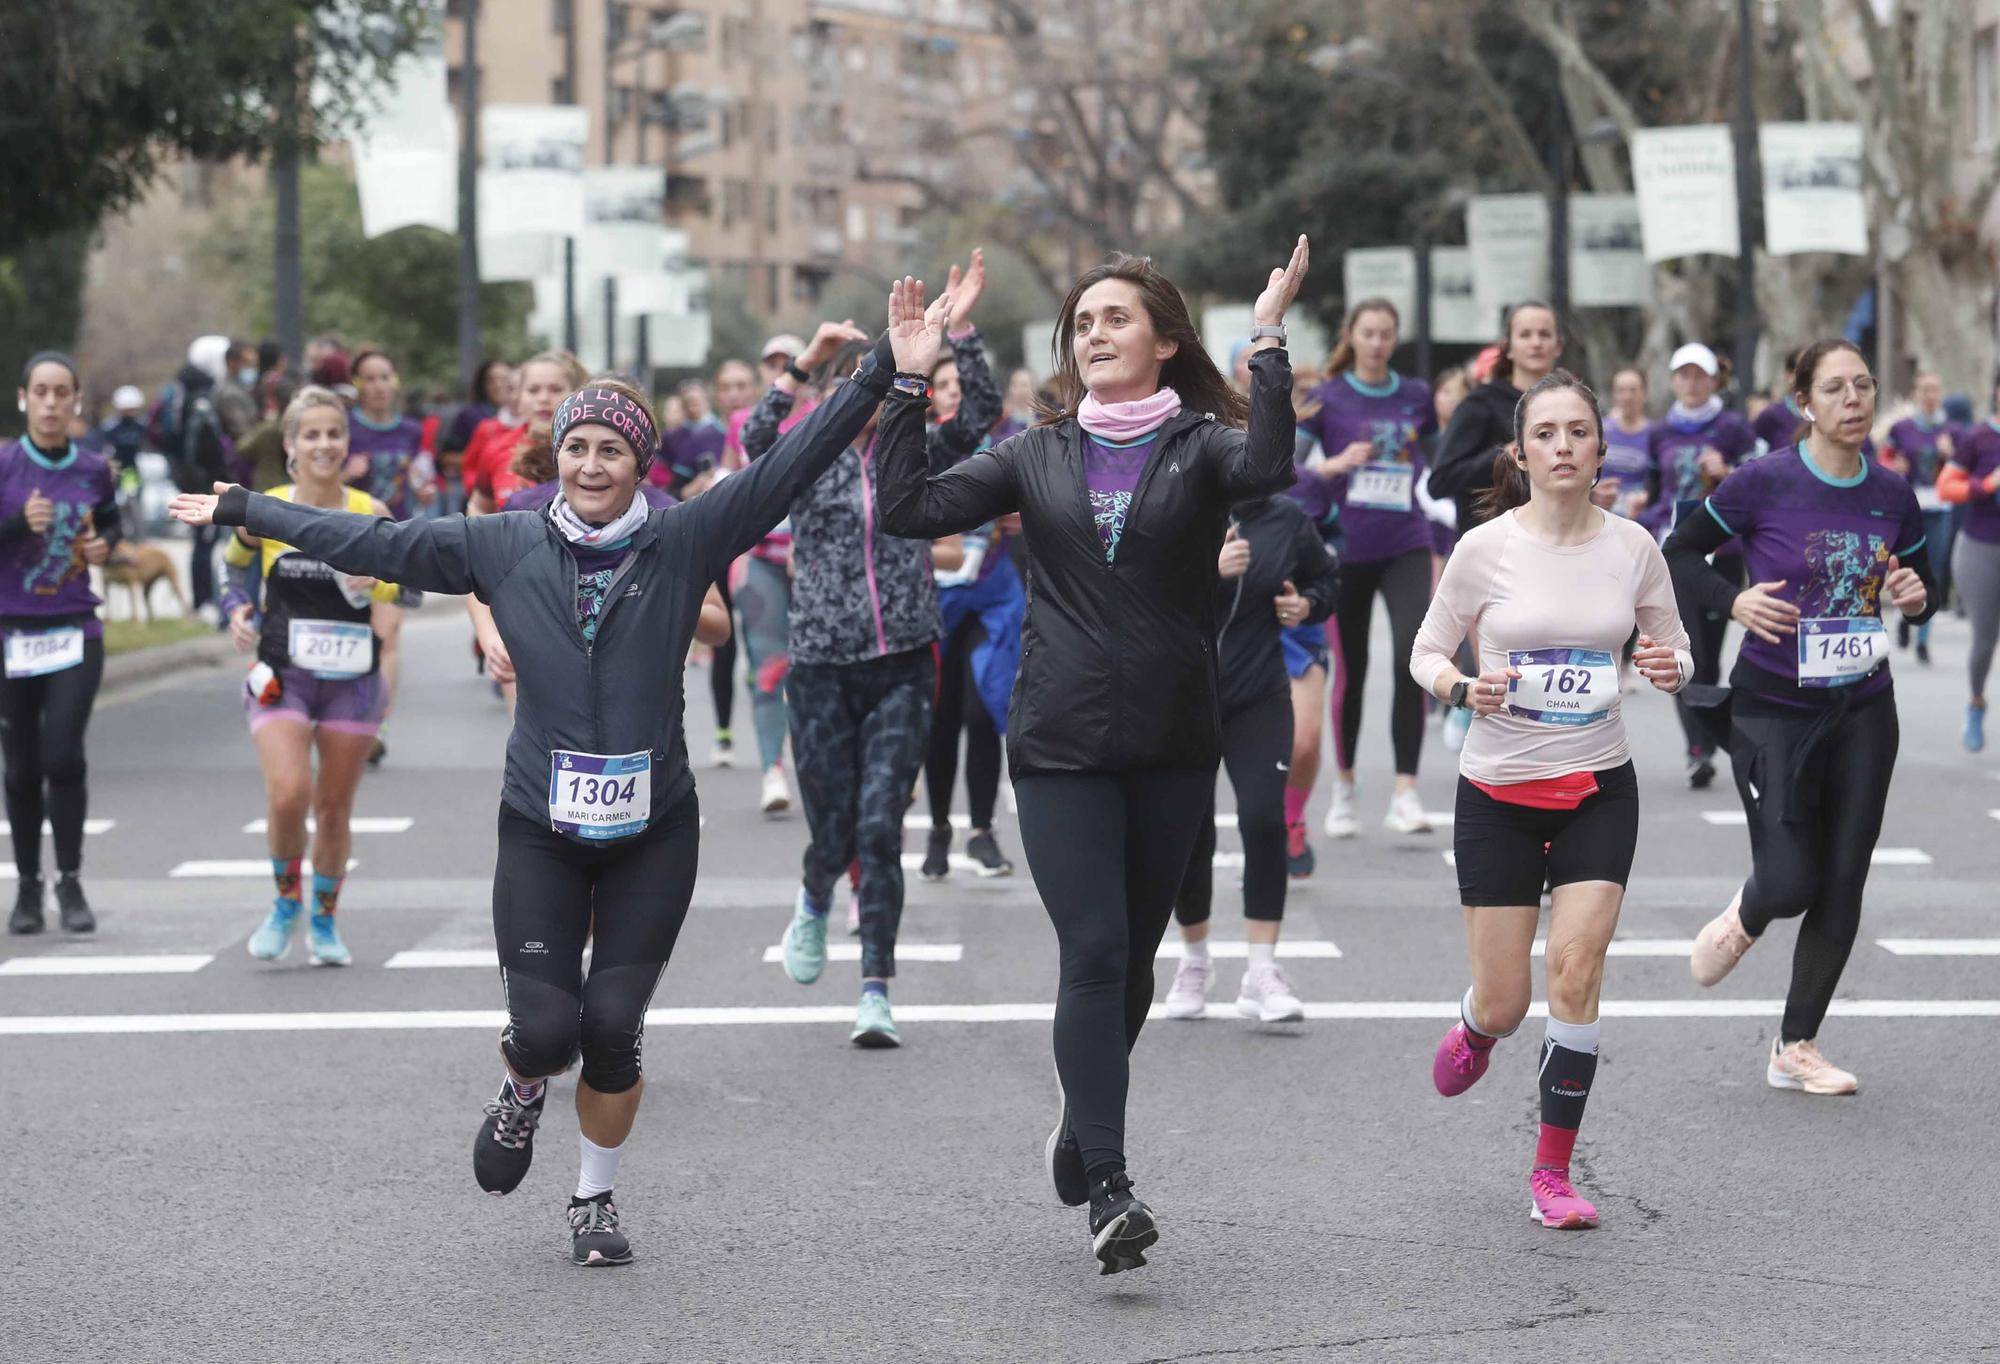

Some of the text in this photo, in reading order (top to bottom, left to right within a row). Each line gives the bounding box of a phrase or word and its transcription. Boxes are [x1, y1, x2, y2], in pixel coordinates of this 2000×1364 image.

[570, 404, 596, 423] DE
[596, 389, 619, 404] LA
[625, 399, 652, 433] SAN
[306, 638, 358, 657] 2017
[1819, 635, 1873, 660] 1461
[1541, 668, 1592, 694] 162
[1546, 700, 1580, 709] CHANA
[569, 776, 636, 806] 1304
[568, 810, 631, 822] MARI CARMEN
